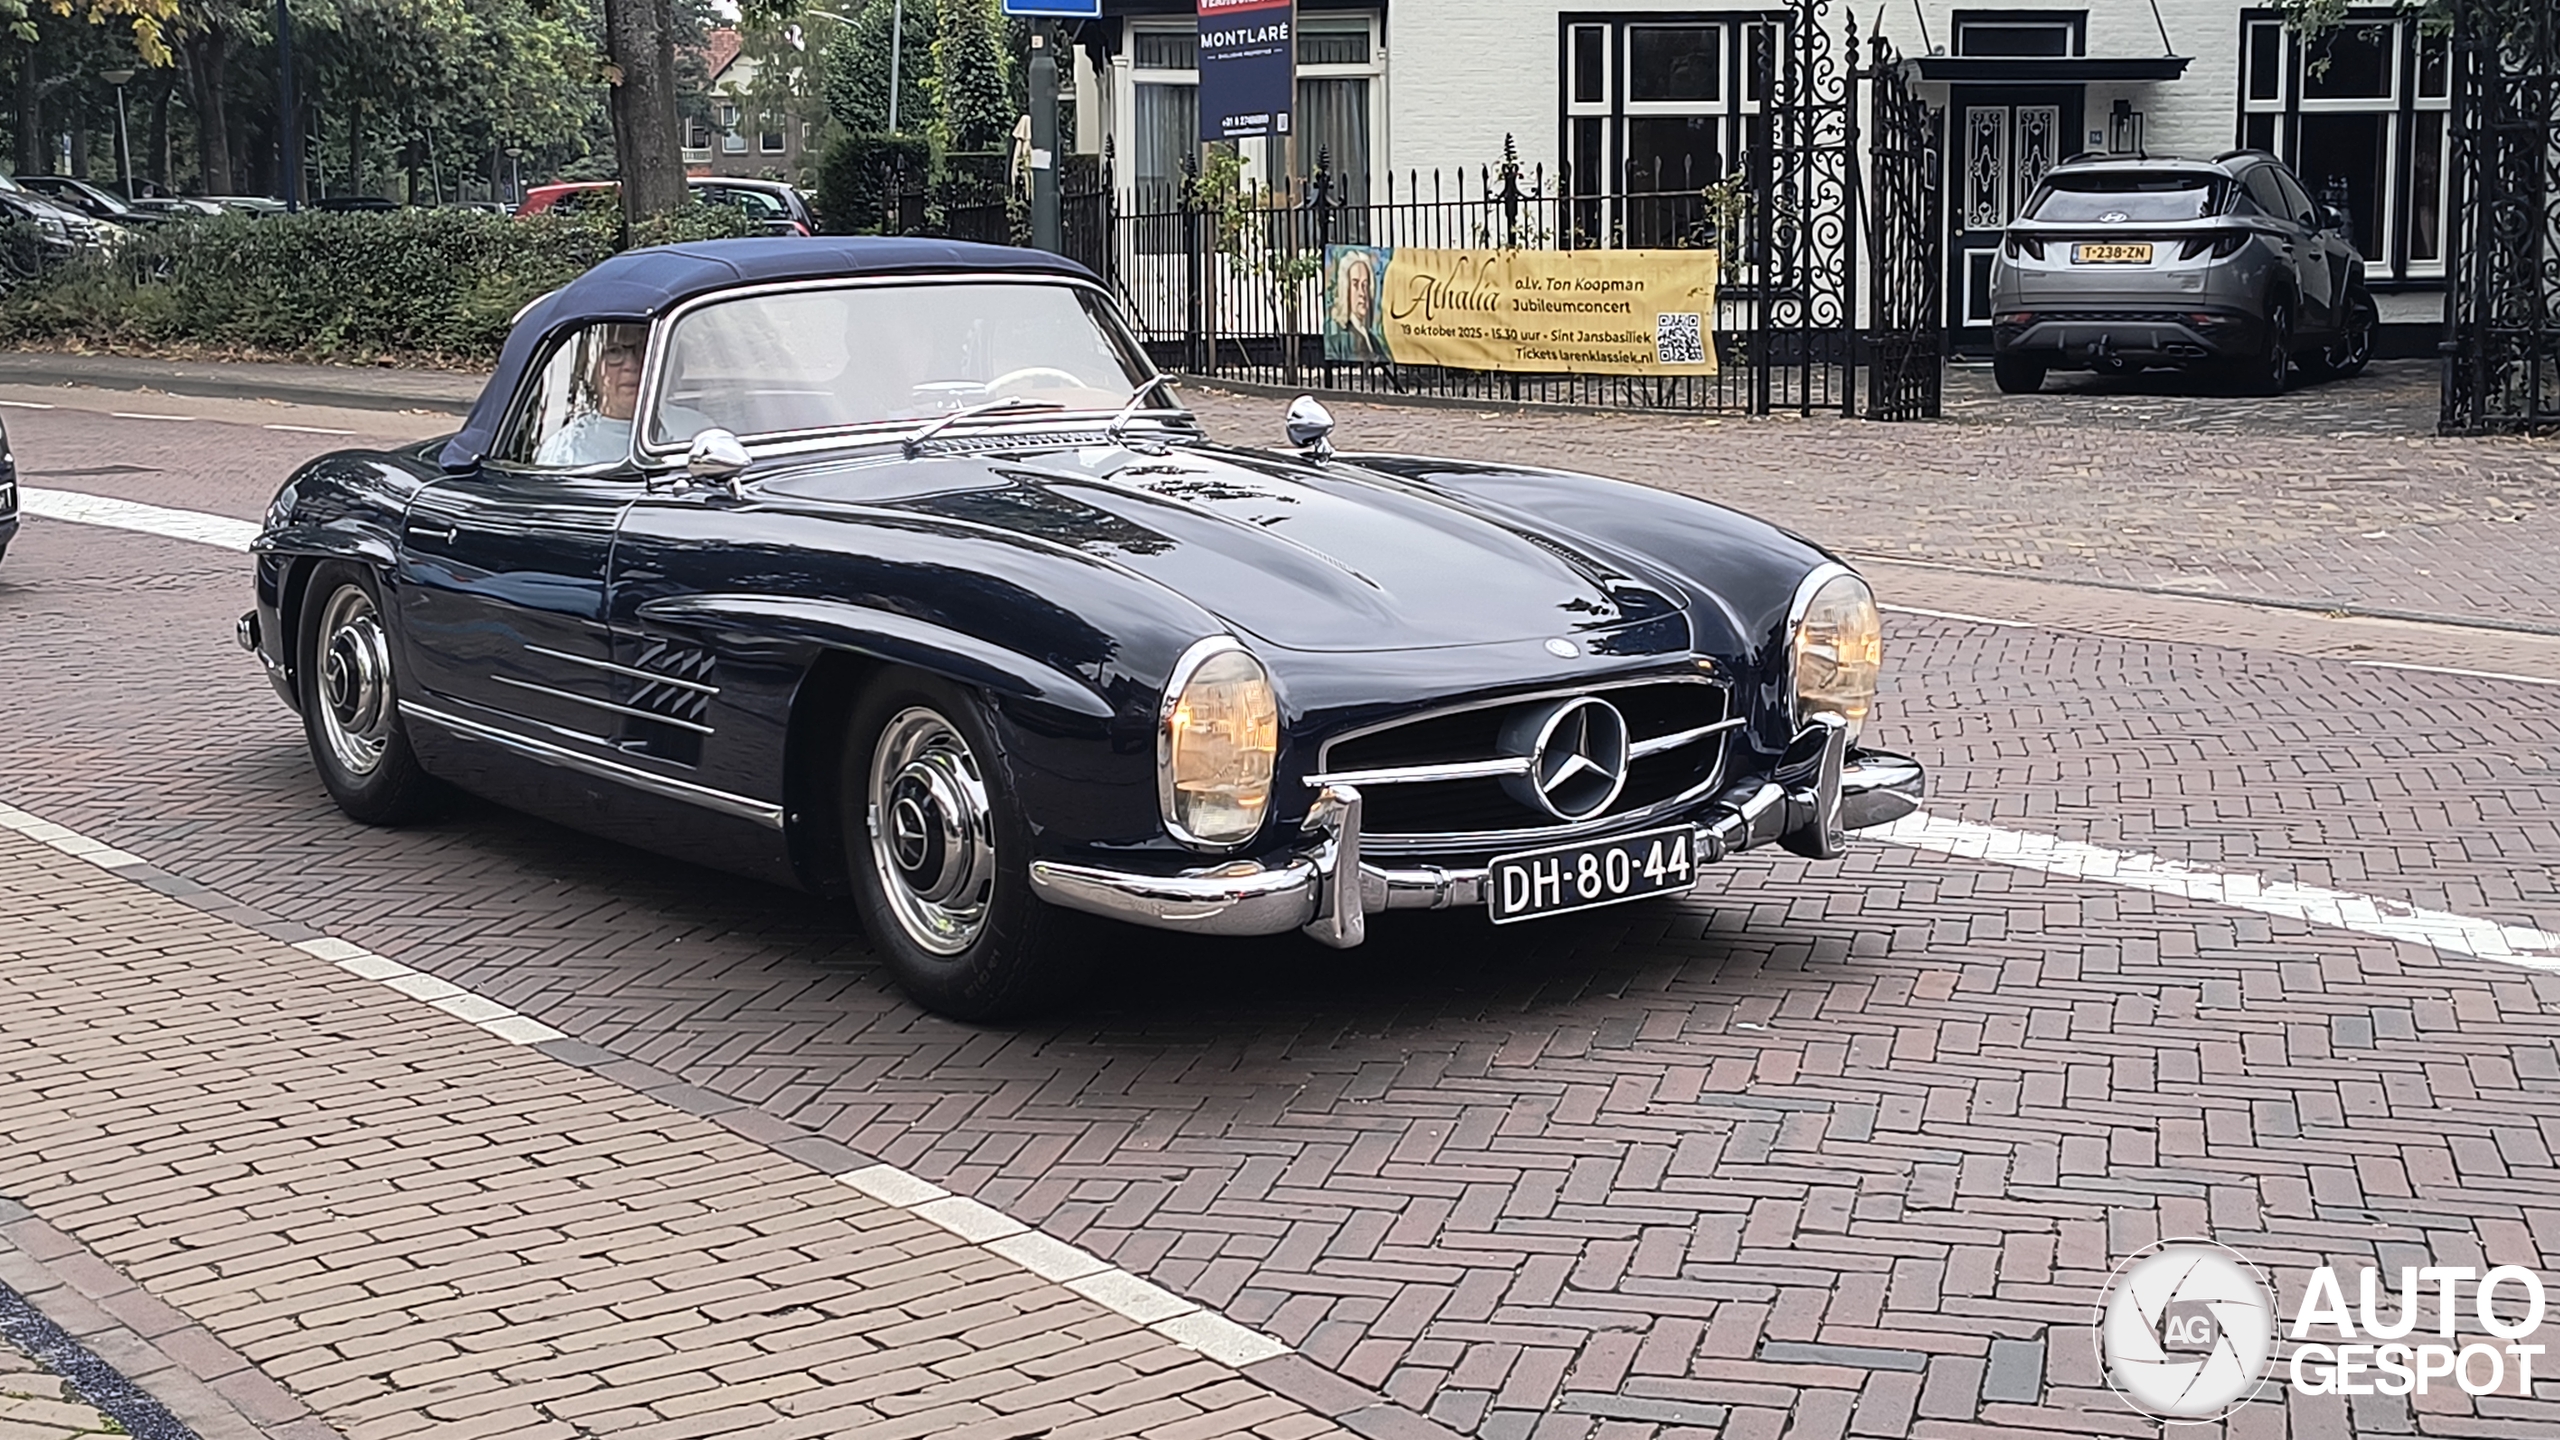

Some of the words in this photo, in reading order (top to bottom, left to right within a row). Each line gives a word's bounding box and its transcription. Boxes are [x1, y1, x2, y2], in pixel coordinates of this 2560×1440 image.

[1201, 22, 1288, 48] MONTLARÉ
[2085, 246, 2145, 258] T-238-ZN
[1390, 256, 1499, 321] Athalia
[1546, 277, 1571, 291] Ton
[1575, 277, 1644, 294] Koopman
[1512, 298, 1631, 314] Jubileumconcert
[1414, 324, 1456, 337] oktober
[1458, 326, 1482, 338] 2025
[1520, 331, 1540, 340] uur
[1551, 329, 1574, 342] Sint
[1577, 330, 1652, 344] Jansbasiliek
[1559, 349, 1654, 364] larenklassiek.nl
[1503, 835, 1690, 914] DH-80-44
